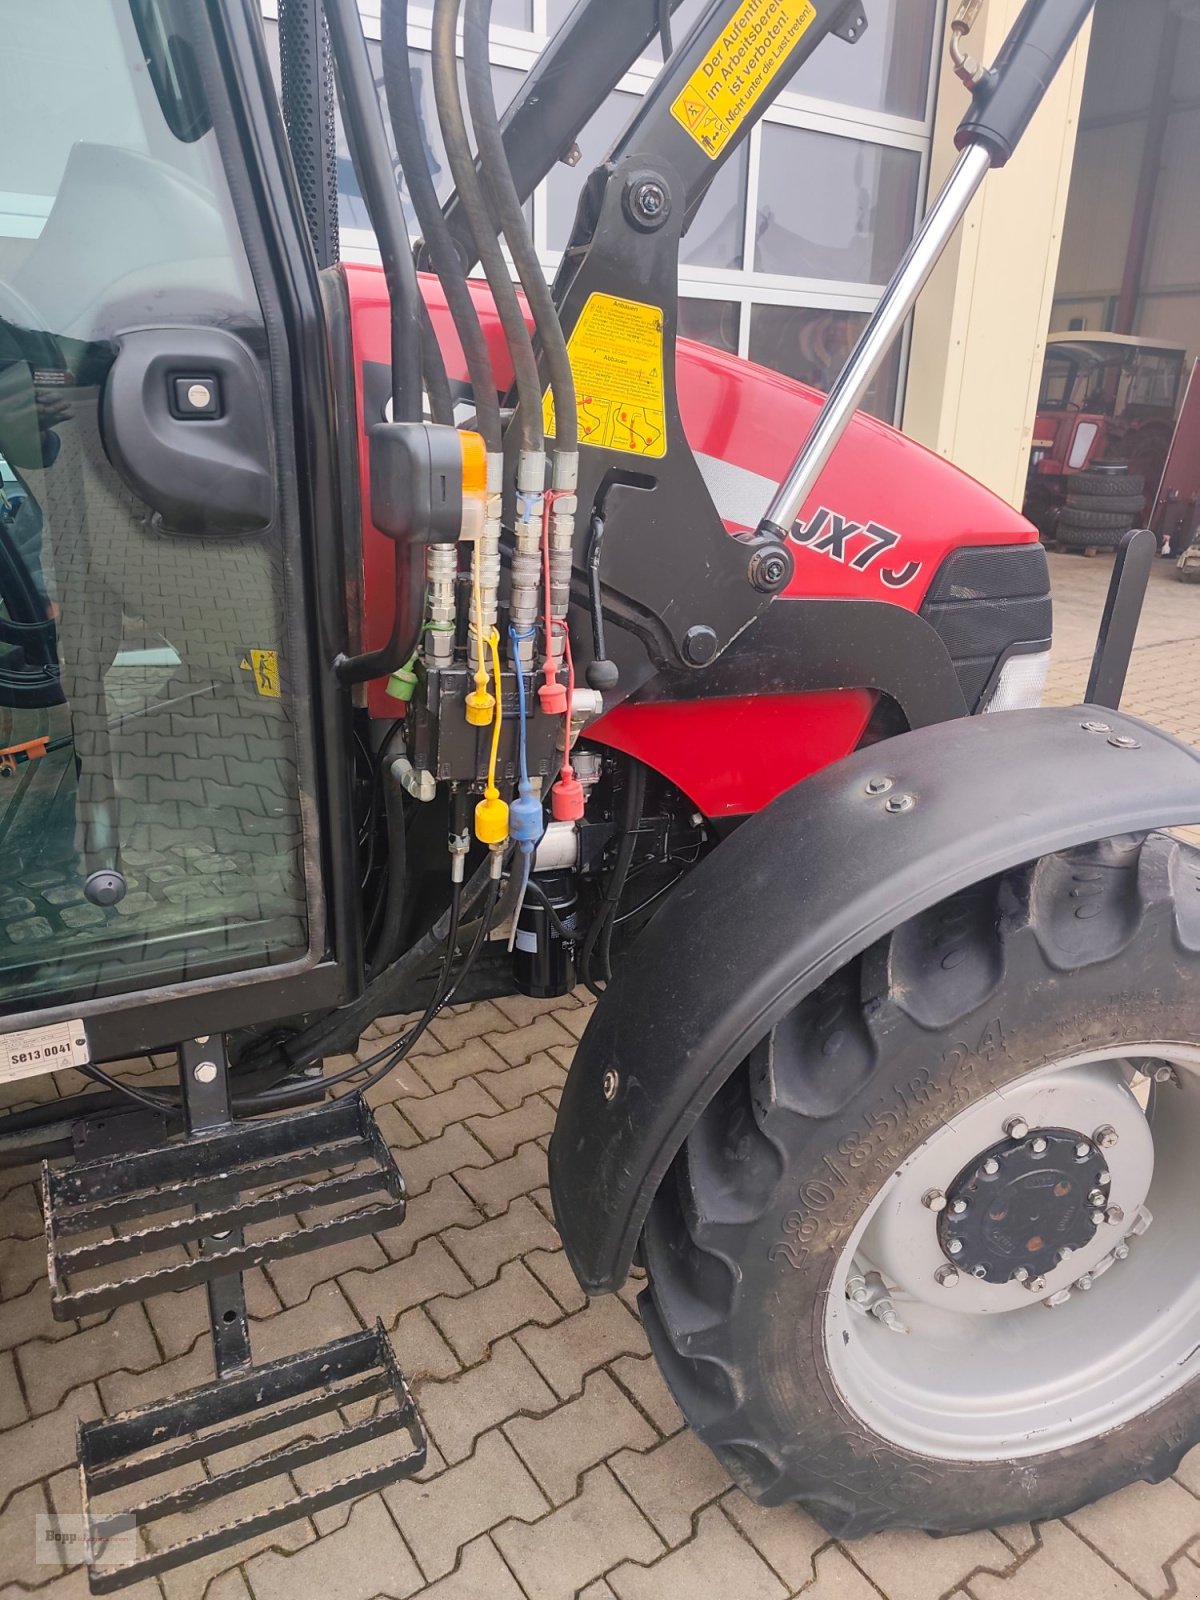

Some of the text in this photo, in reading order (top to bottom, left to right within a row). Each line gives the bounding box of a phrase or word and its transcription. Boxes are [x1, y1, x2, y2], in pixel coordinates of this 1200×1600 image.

[702, 50, 724, 78] Der
[705, 0, 784, 101] im Arbeitsberei
[725, 5, 812, 126] Nicht unter die Last treten!
[728, 10, 789, 96] ist verboten!
[44, 1043, 71, 1057] 0041
